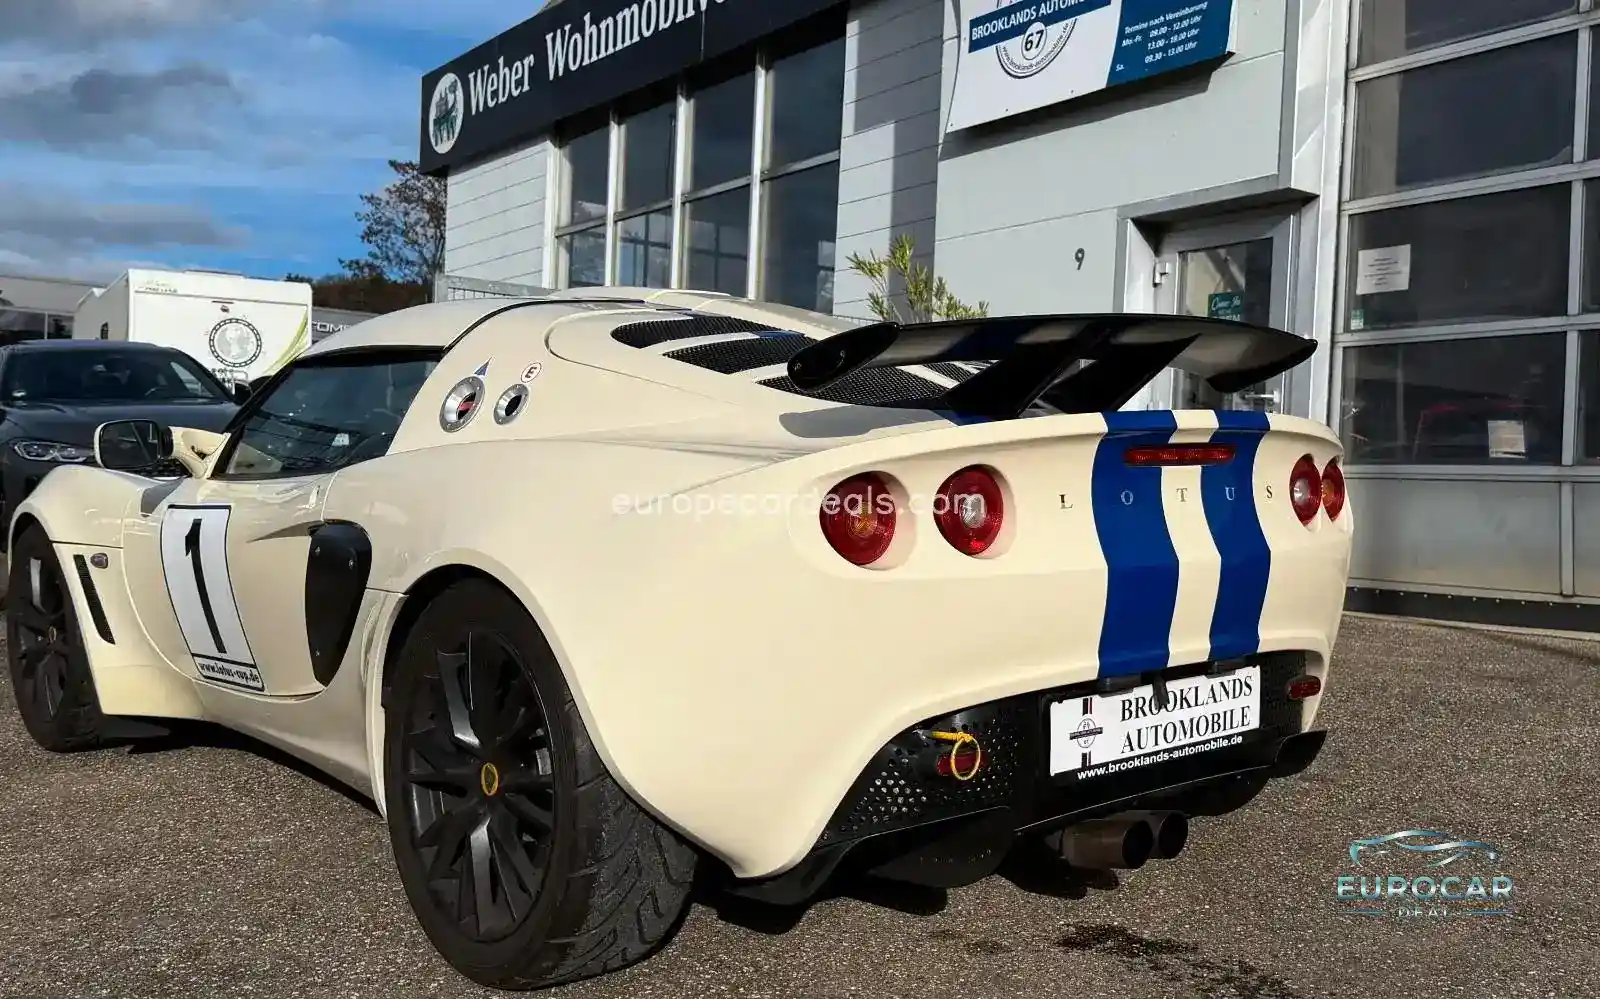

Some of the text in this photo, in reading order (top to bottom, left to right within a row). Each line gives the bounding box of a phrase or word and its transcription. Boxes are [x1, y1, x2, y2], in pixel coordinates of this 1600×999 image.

[971, 5, 1037, 41] BROOKLANDS
[1124, 2, 1208, 35] Termine nach Vereinbarung
[1187, 28, 1200, 38] Uhr
[1190, 15, 1203, 25] Uhr
[1024, 29, 1044, 51] 67
[1184, 41, 1198, 51] Uhr
[468, 53, 535, 116] Weber
[1074, 248, 1085, 271] 9
[525, 365, 539, 381] E
[1058, 485, 1274, 510] LOTUS
[184, 518, 228, 654] 1
[1120, 675, 1253, 722] BROOKLANDS
[1120, 705, 1251, 754] AUTOMOBILE
[1077, 734, 1243, 781] www.brooklands-automobile.de
